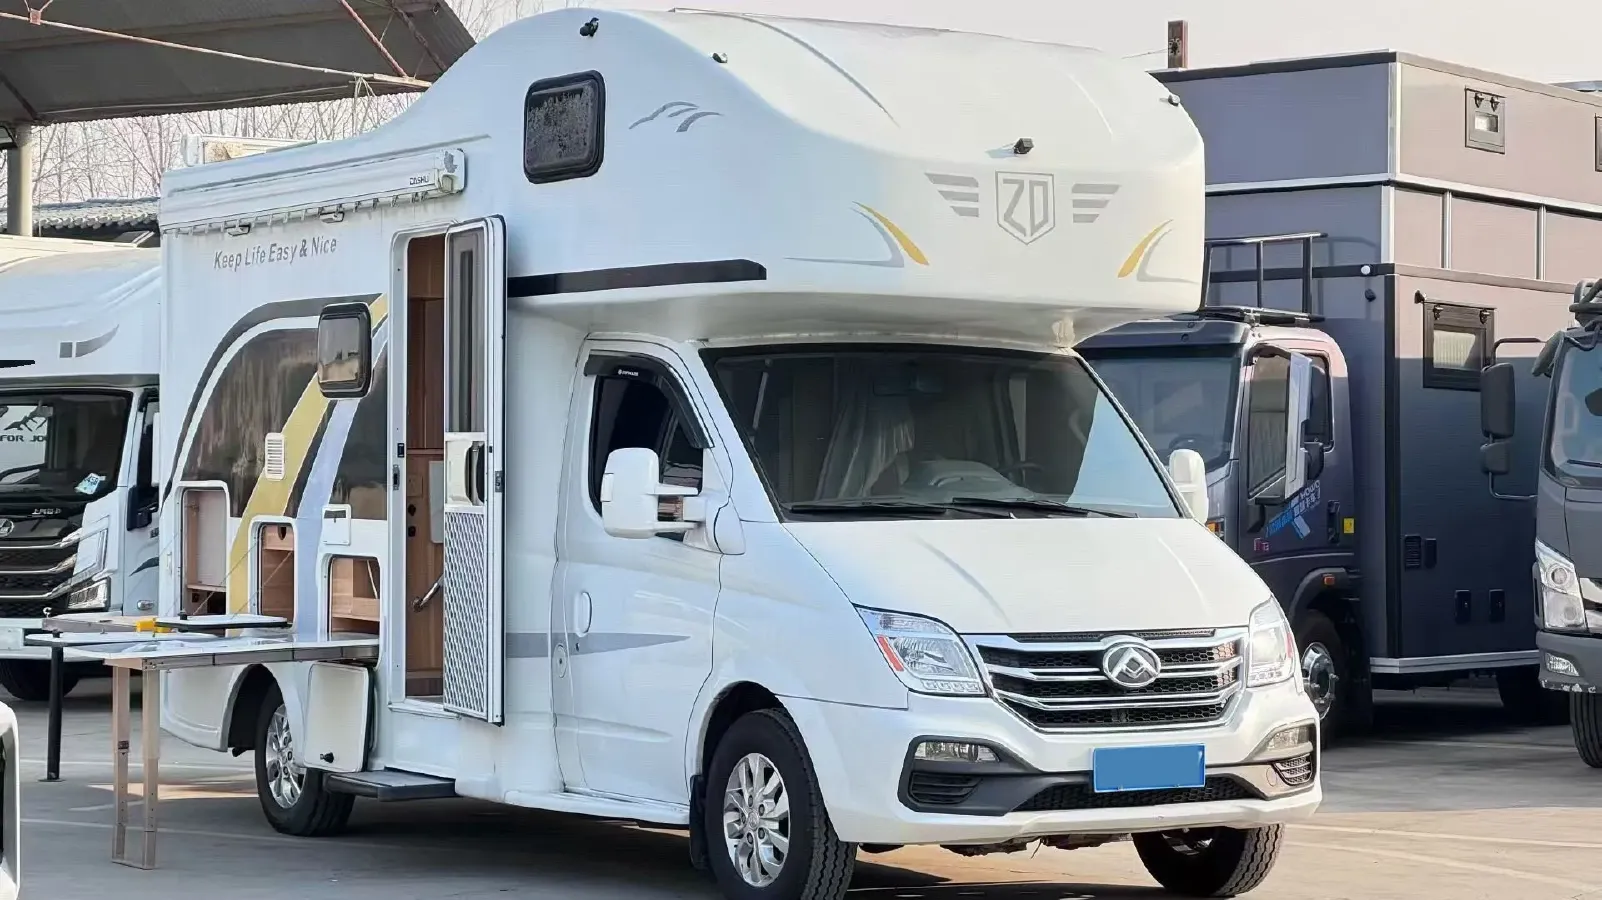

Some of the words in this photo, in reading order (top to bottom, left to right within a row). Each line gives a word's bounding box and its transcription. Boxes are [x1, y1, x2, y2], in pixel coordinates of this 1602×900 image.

[214, 250, 242, 272] Keep
[245, 245, 266, 266] Life
[268, 242, 297, 264] Easy
[299, 238, 308, 258] &
[311, 235, 337, 257] Nice
